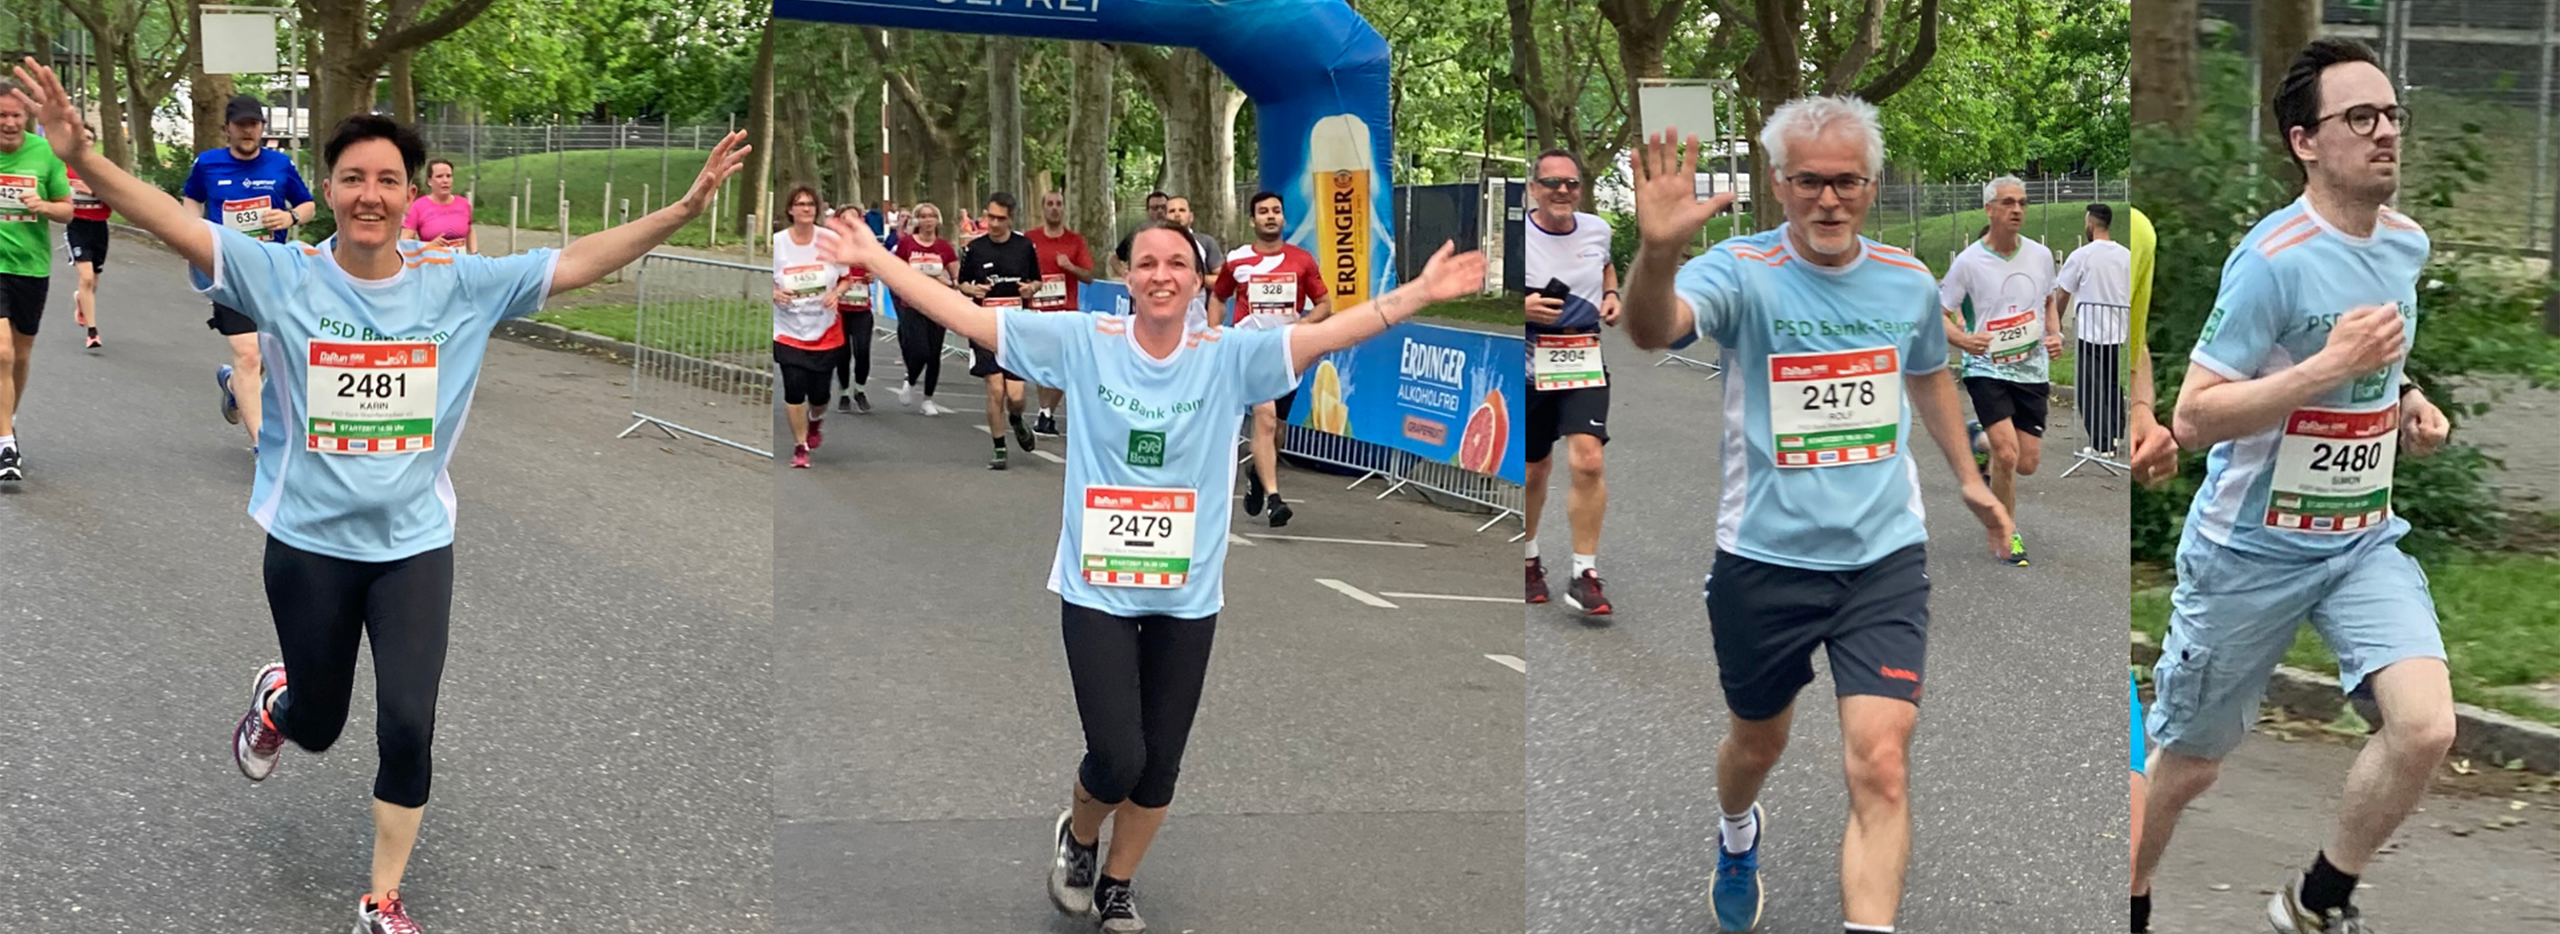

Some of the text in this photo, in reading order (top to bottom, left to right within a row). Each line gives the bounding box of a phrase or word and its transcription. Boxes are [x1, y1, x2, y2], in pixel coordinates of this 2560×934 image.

[236, 211, 259, 223] 633
[1333, 188, 1357, 296] ERDINGER
[1262, 284, 1283, 295] 328
[2008, 305, 2017, 313] IT
[319, 317, 356, 338] PSD
[1773, 319, 1813, 337] PSD
[1999, 326, 2028, 342] 2291
[1400, 337, 1467, 391] ERDINGER
[1549, 350, 1586, 363] 2304
[337, 373, 406, 399] 2481
[1098, 384, 1126, 408] PSD
[1802, 380, 1875, 411] 2478
[359, 402, 389, 410] KARIN
[1397, 384, 1460, 412] ALKOHOLFREI
[1130, 452, 1161, 465] Bank
[2309, 442, 2382, 473] 2480
[1108, 514, 1173, 538] 2479
